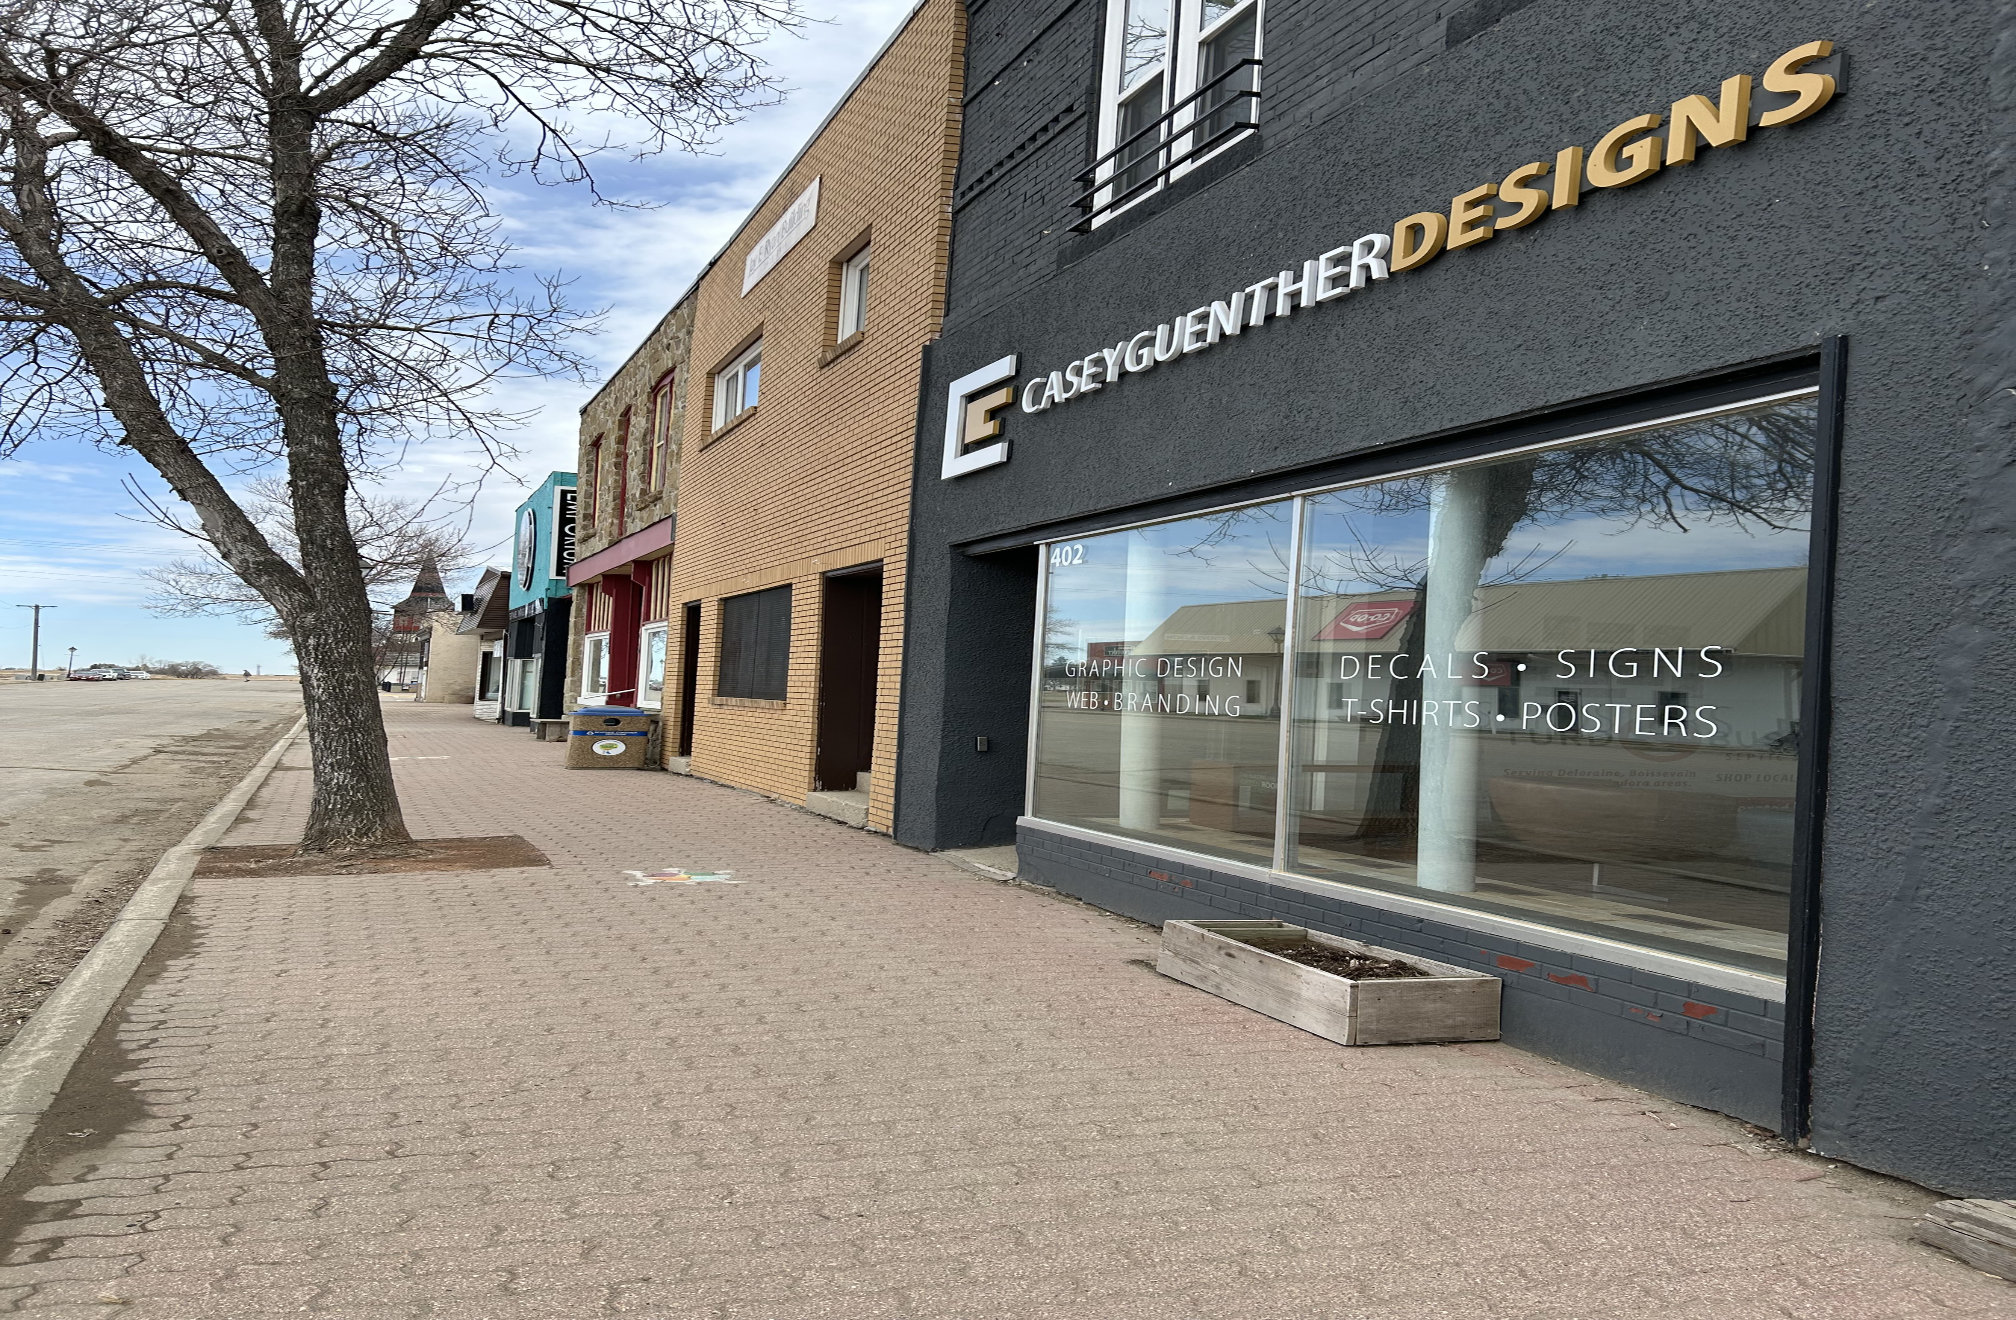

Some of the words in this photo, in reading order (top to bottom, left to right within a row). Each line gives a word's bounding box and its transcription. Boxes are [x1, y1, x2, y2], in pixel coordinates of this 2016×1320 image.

[1051, 543, 1084, 567] 402
[1065, 658, 1147, 678] GRAPHIC
[1157, 656, 1243, 678] DESIGN
[1340, 651, 1490, 680] DECALS
[1556, 645, 1723, 679] SIGNS
[1114, 692, 1240, 717] BRANDING
[1341, 698, 1481, 729] T-SHIRTS
[1522, 701, 1718, 739] POSTERS
